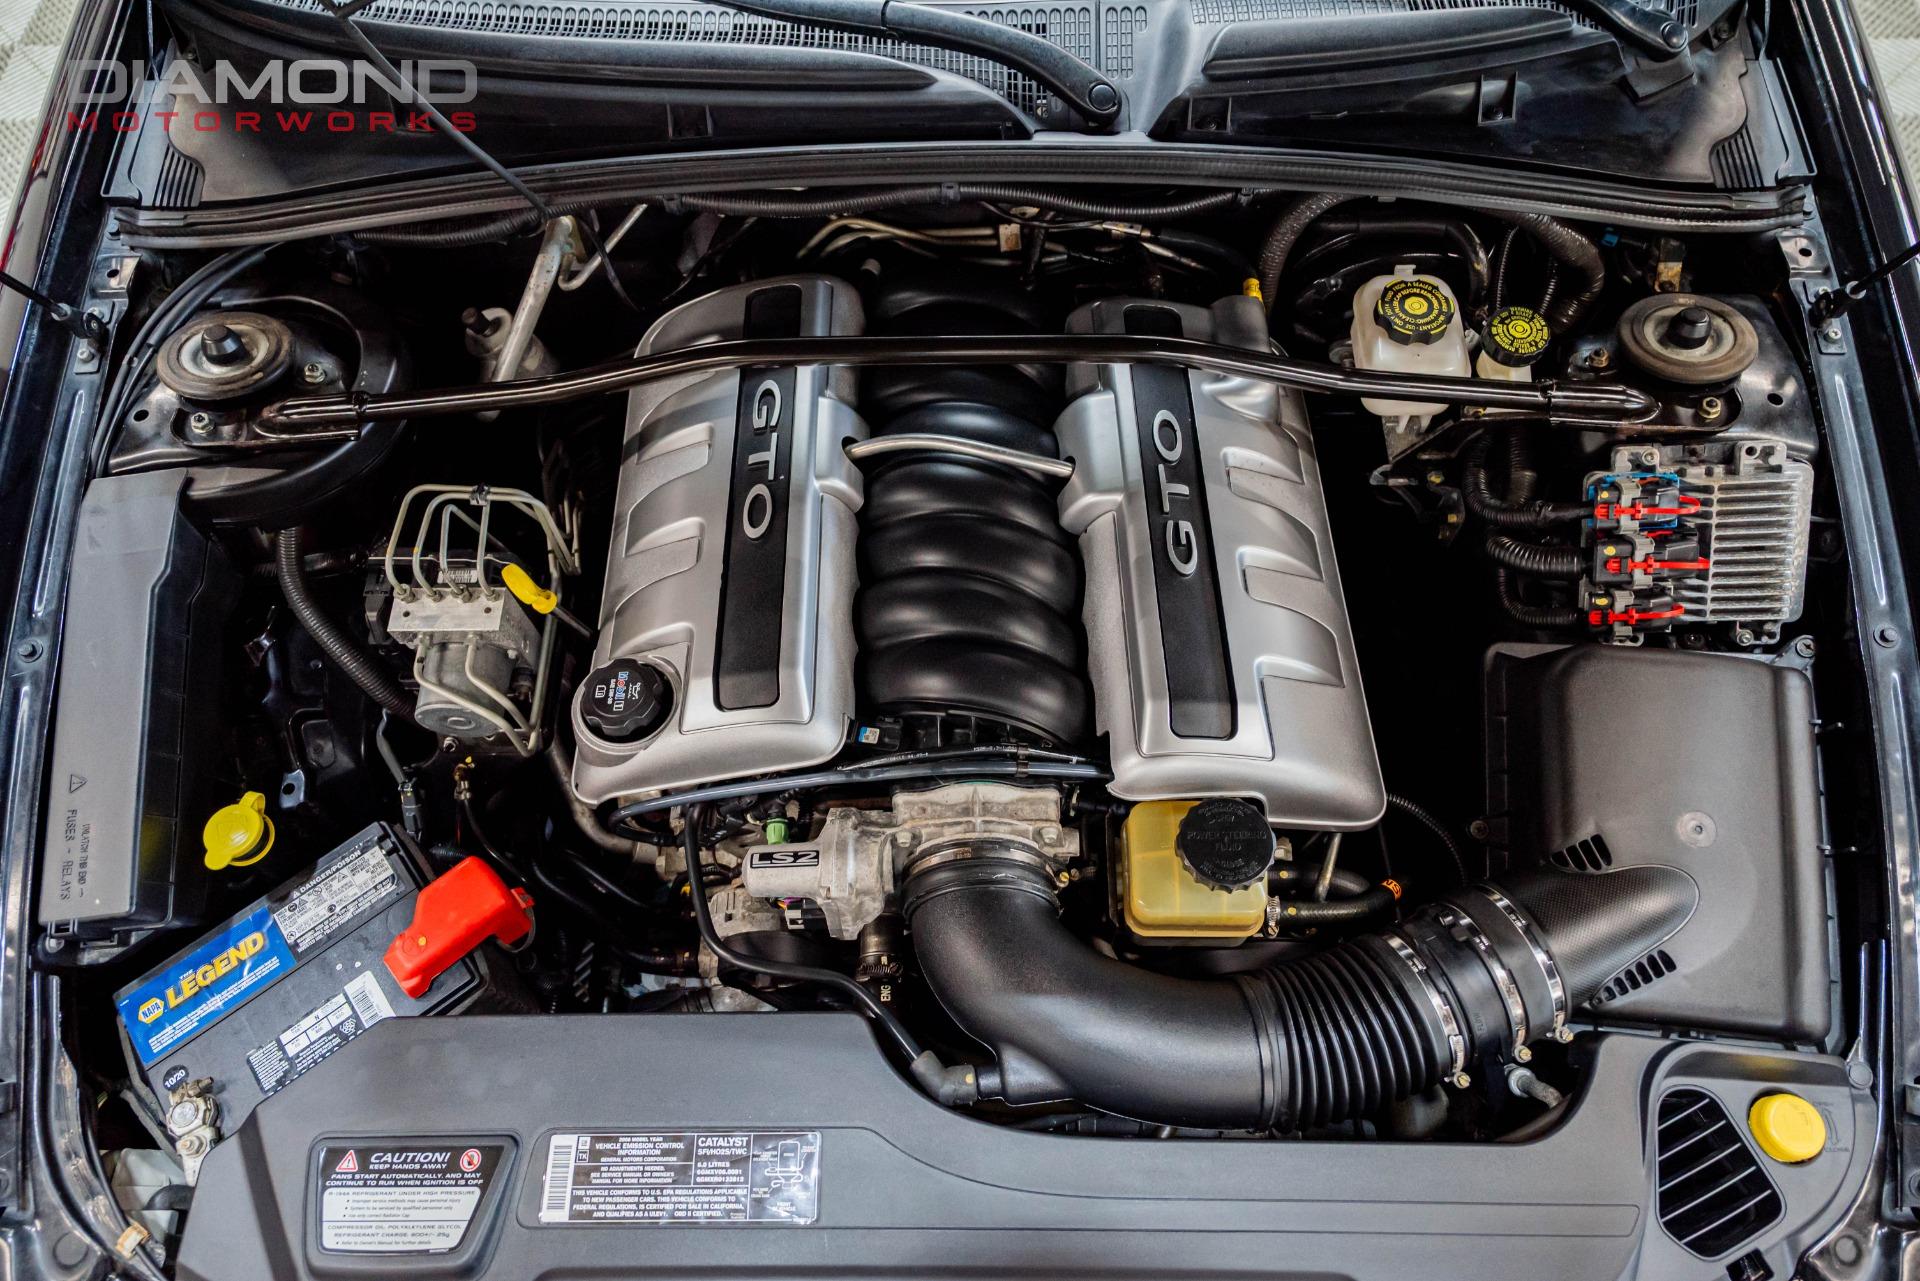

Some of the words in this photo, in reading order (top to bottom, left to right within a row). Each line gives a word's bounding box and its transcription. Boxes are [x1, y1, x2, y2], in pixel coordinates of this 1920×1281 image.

[1412, 282, 1432, 290] SEALED
[742, 378, 782, 540] GTO
[1152, 409, 1198, 576] GTO
[615, 672, 628, 700] Mobil
[65, 809, 78, 842] FUSES
[752, 851, 818, 864] LS2
[60, 860, 73, 900] RELAYS
[300, 850, 361, 892] DANGER/POISON
[165, 932, 265, 1009] LEGEND
[881, 985, 891, 1001] ENG
[141, 1002, 160, 1019] NAPA
[164, 1069, 186, 1088] 10/20
[698, 1137, 748, 1146] CATALYST
[370, 1152, 451, 1163] CAUTION!
